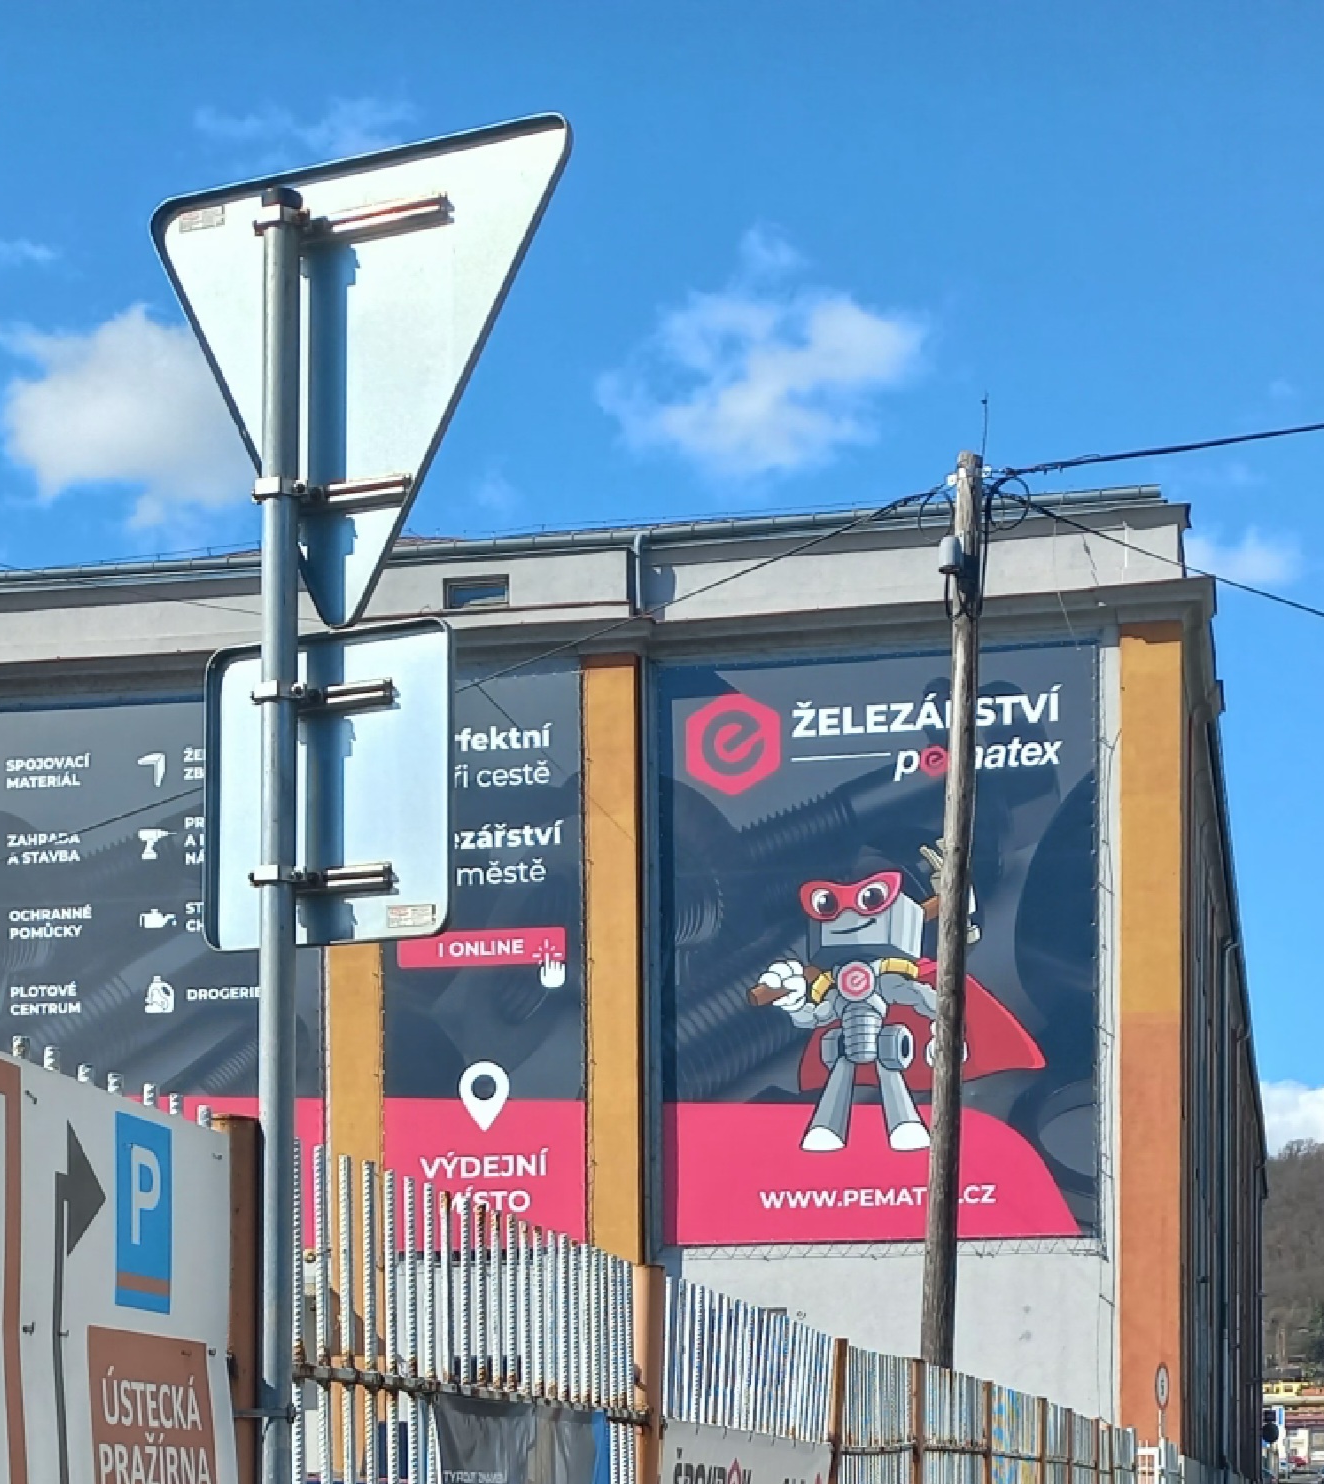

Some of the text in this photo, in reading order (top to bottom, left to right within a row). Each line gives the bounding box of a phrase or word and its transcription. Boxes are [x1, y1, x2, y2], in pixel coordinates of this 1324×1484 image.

[791, 684, 1063, 739] ŽELEZÁSTVÍ
[455, 722, 553, 751] fektní
[5, 752, 91, 772] SPOJOVACÍ
[893, 736, 1063, 782] peatex
[6, 772, 81, 789] MATERIÁL
[476, 759, 551, 788] cestě
[455, 819, 564, 850] zářství
[7, 850, 80, 865] A STAVBA
[456, 857, 547, 887] městě
[8, 903, 92, 922] OCHRANNÉ
[9, 922, 83, 940] POMŮCKY
[449, 939, 524, 957] ONLINE
[10, 980, 77, 998] PLOTOVÉ
[10, 1002, 81, 1016] CENTRUM
[420, 1147, 549, 1179] VÝDEJNÍ
[129, 1142, 162, 1246] P
[759, 1184, 997, 1209] WWW.PEMAT.CZ
[102, 1366, 202, 1431] ÚSTECKÁ
